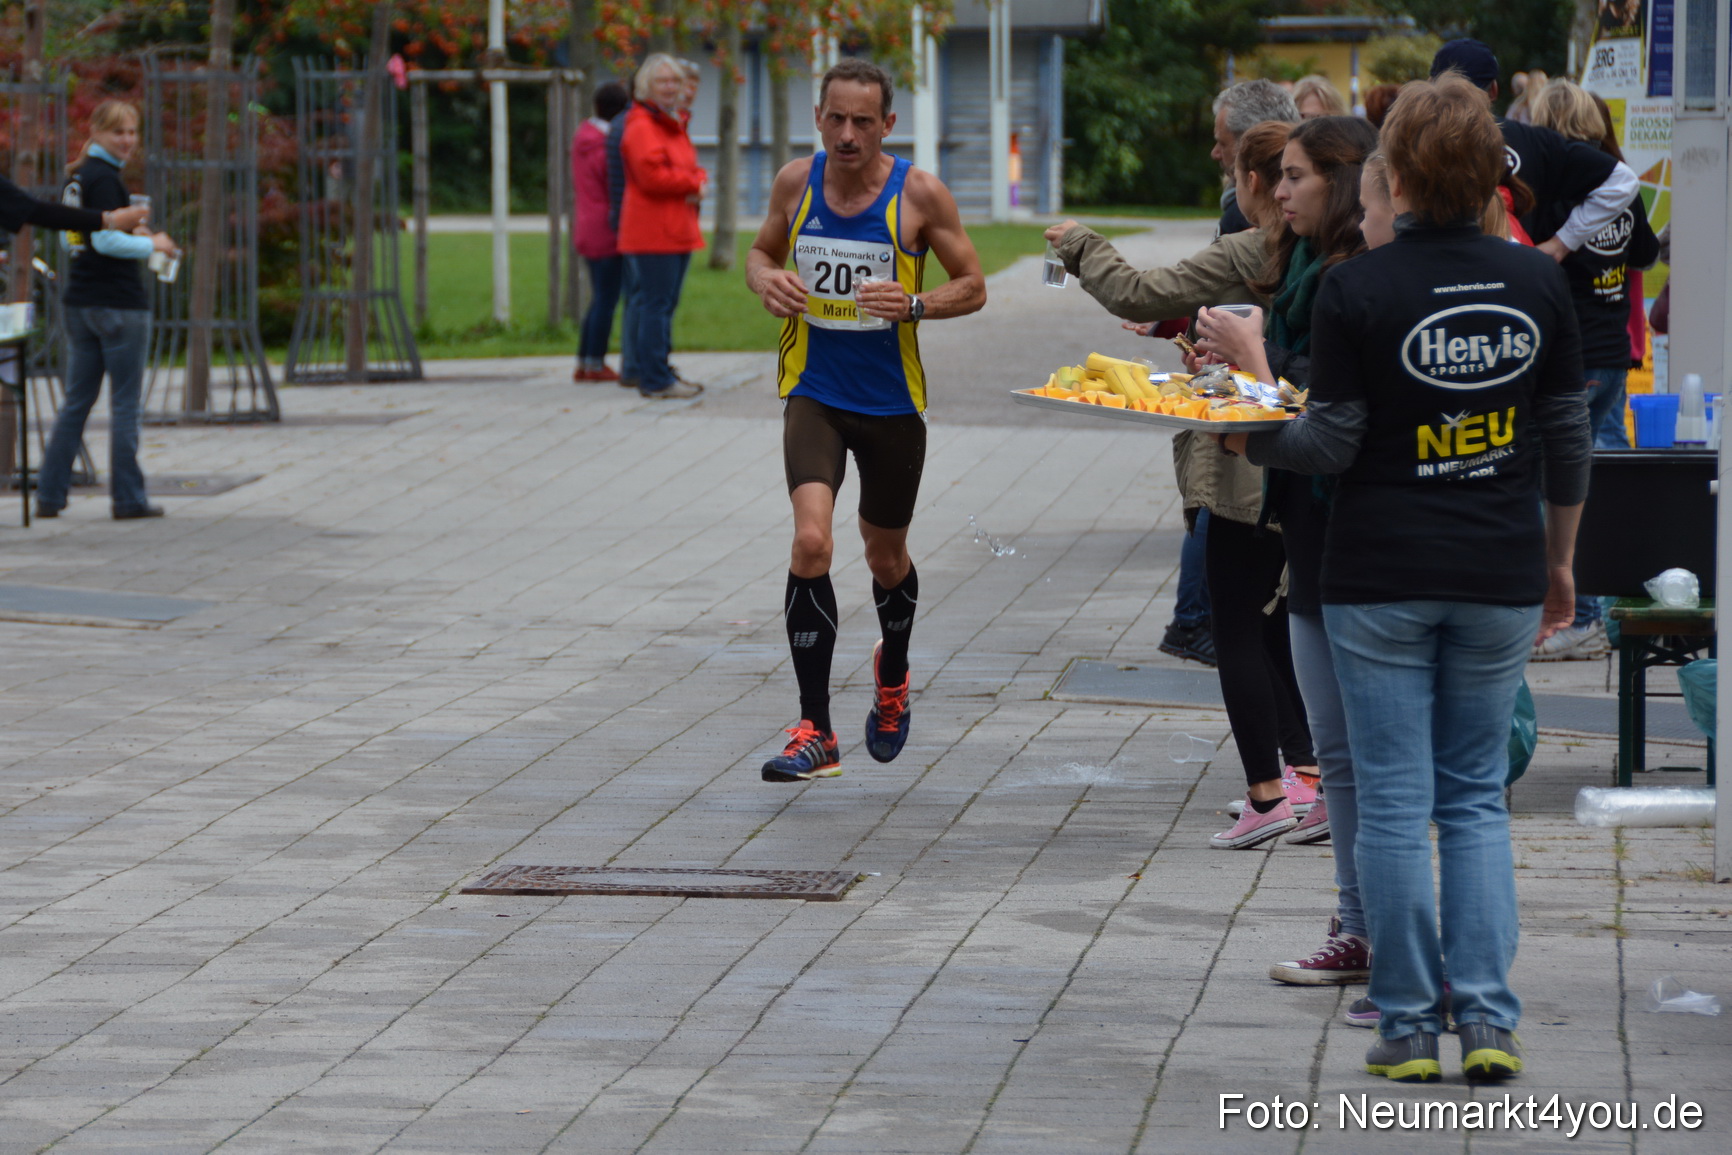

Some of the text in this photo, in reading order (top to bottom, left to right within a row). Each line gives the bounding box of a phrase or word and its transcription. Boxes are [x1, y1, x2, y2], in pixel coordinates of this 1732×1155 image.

[798, 245, 875, 261] PARTL Neumarkt
[1433, 281, 1505, 294] www.hervis.com
[1420, 326, 1531, 368] Hervis
[1430, 362, 1485, 376] SPORTS
[1417, 406, 1516, 460] NEU
[1418, 445, 1515, 477] IN NEUMARKT
